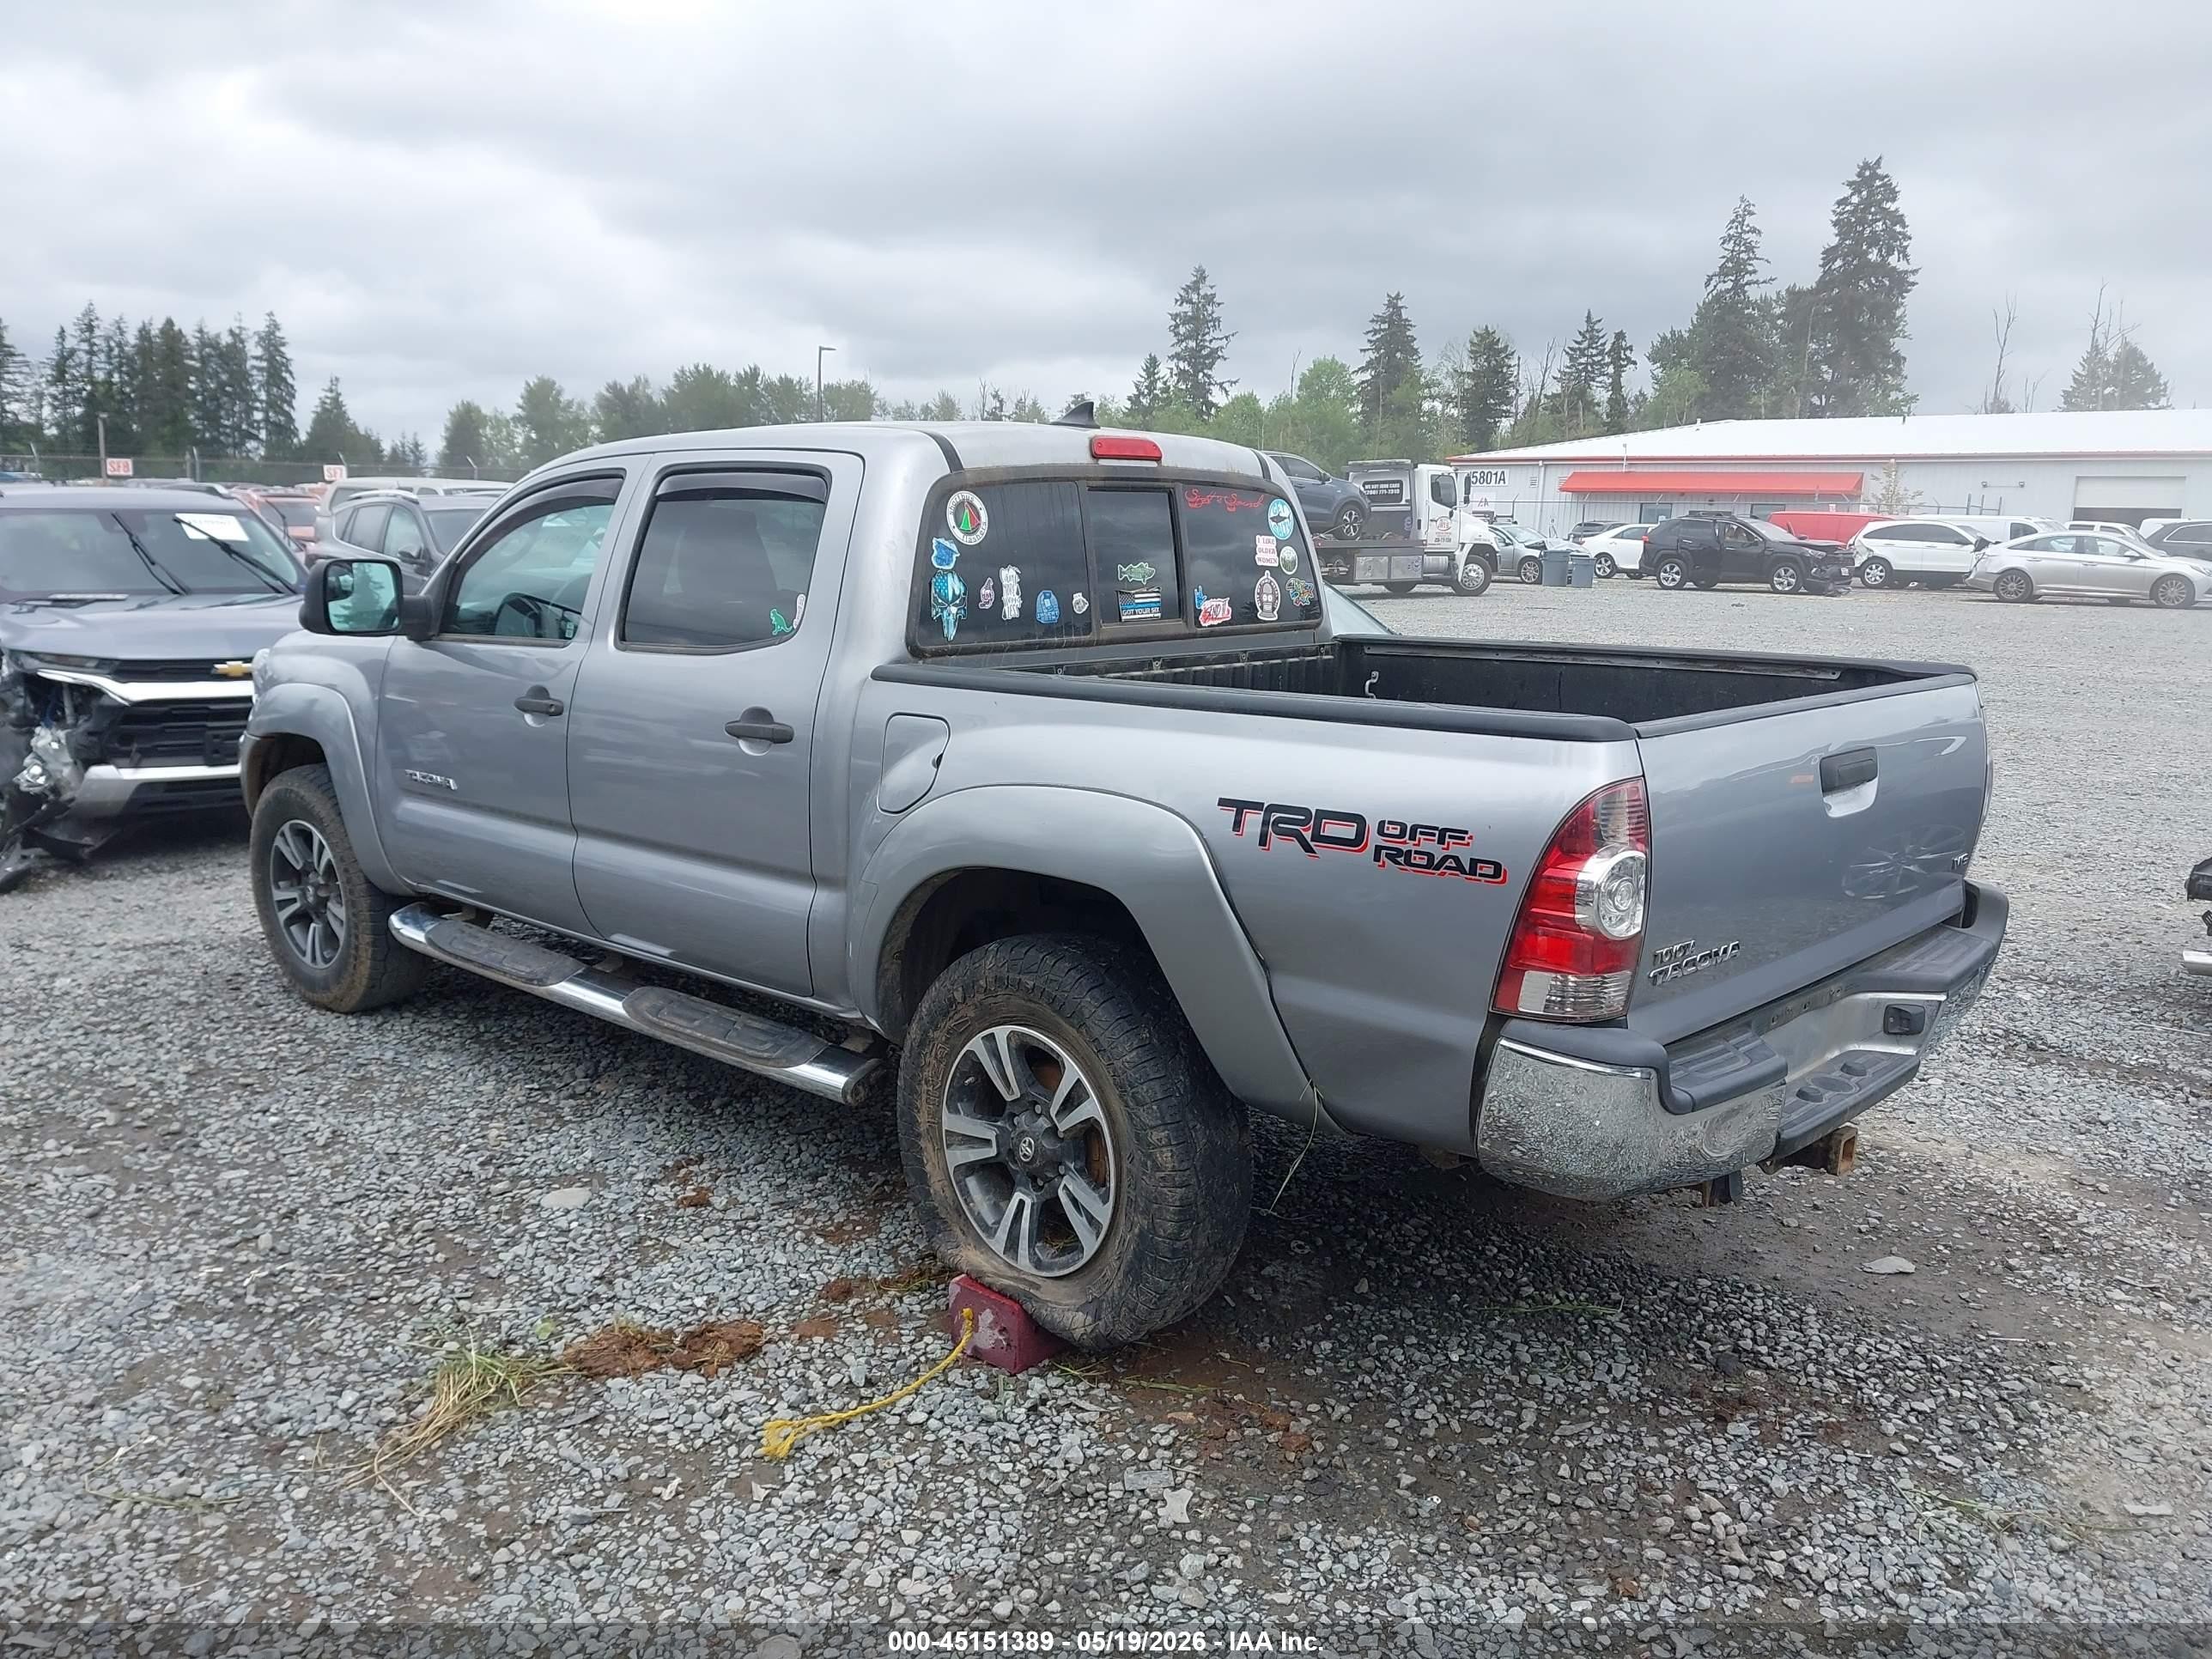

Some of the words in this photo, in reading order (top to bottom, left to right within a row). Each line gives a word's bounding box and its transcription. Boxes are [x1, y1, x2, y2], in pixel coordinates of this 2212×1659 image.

[1470, 471, 1506, 485] 5801A
[1216, 797, 1372, 859] TRD
[1376, 819, 1474, 850] OFF
[1373, 844, 1509, 886] ROAD
[1648, 940, 1741, 986] TACOMA
[1653, 939, 1696, 966] TOYOTA
